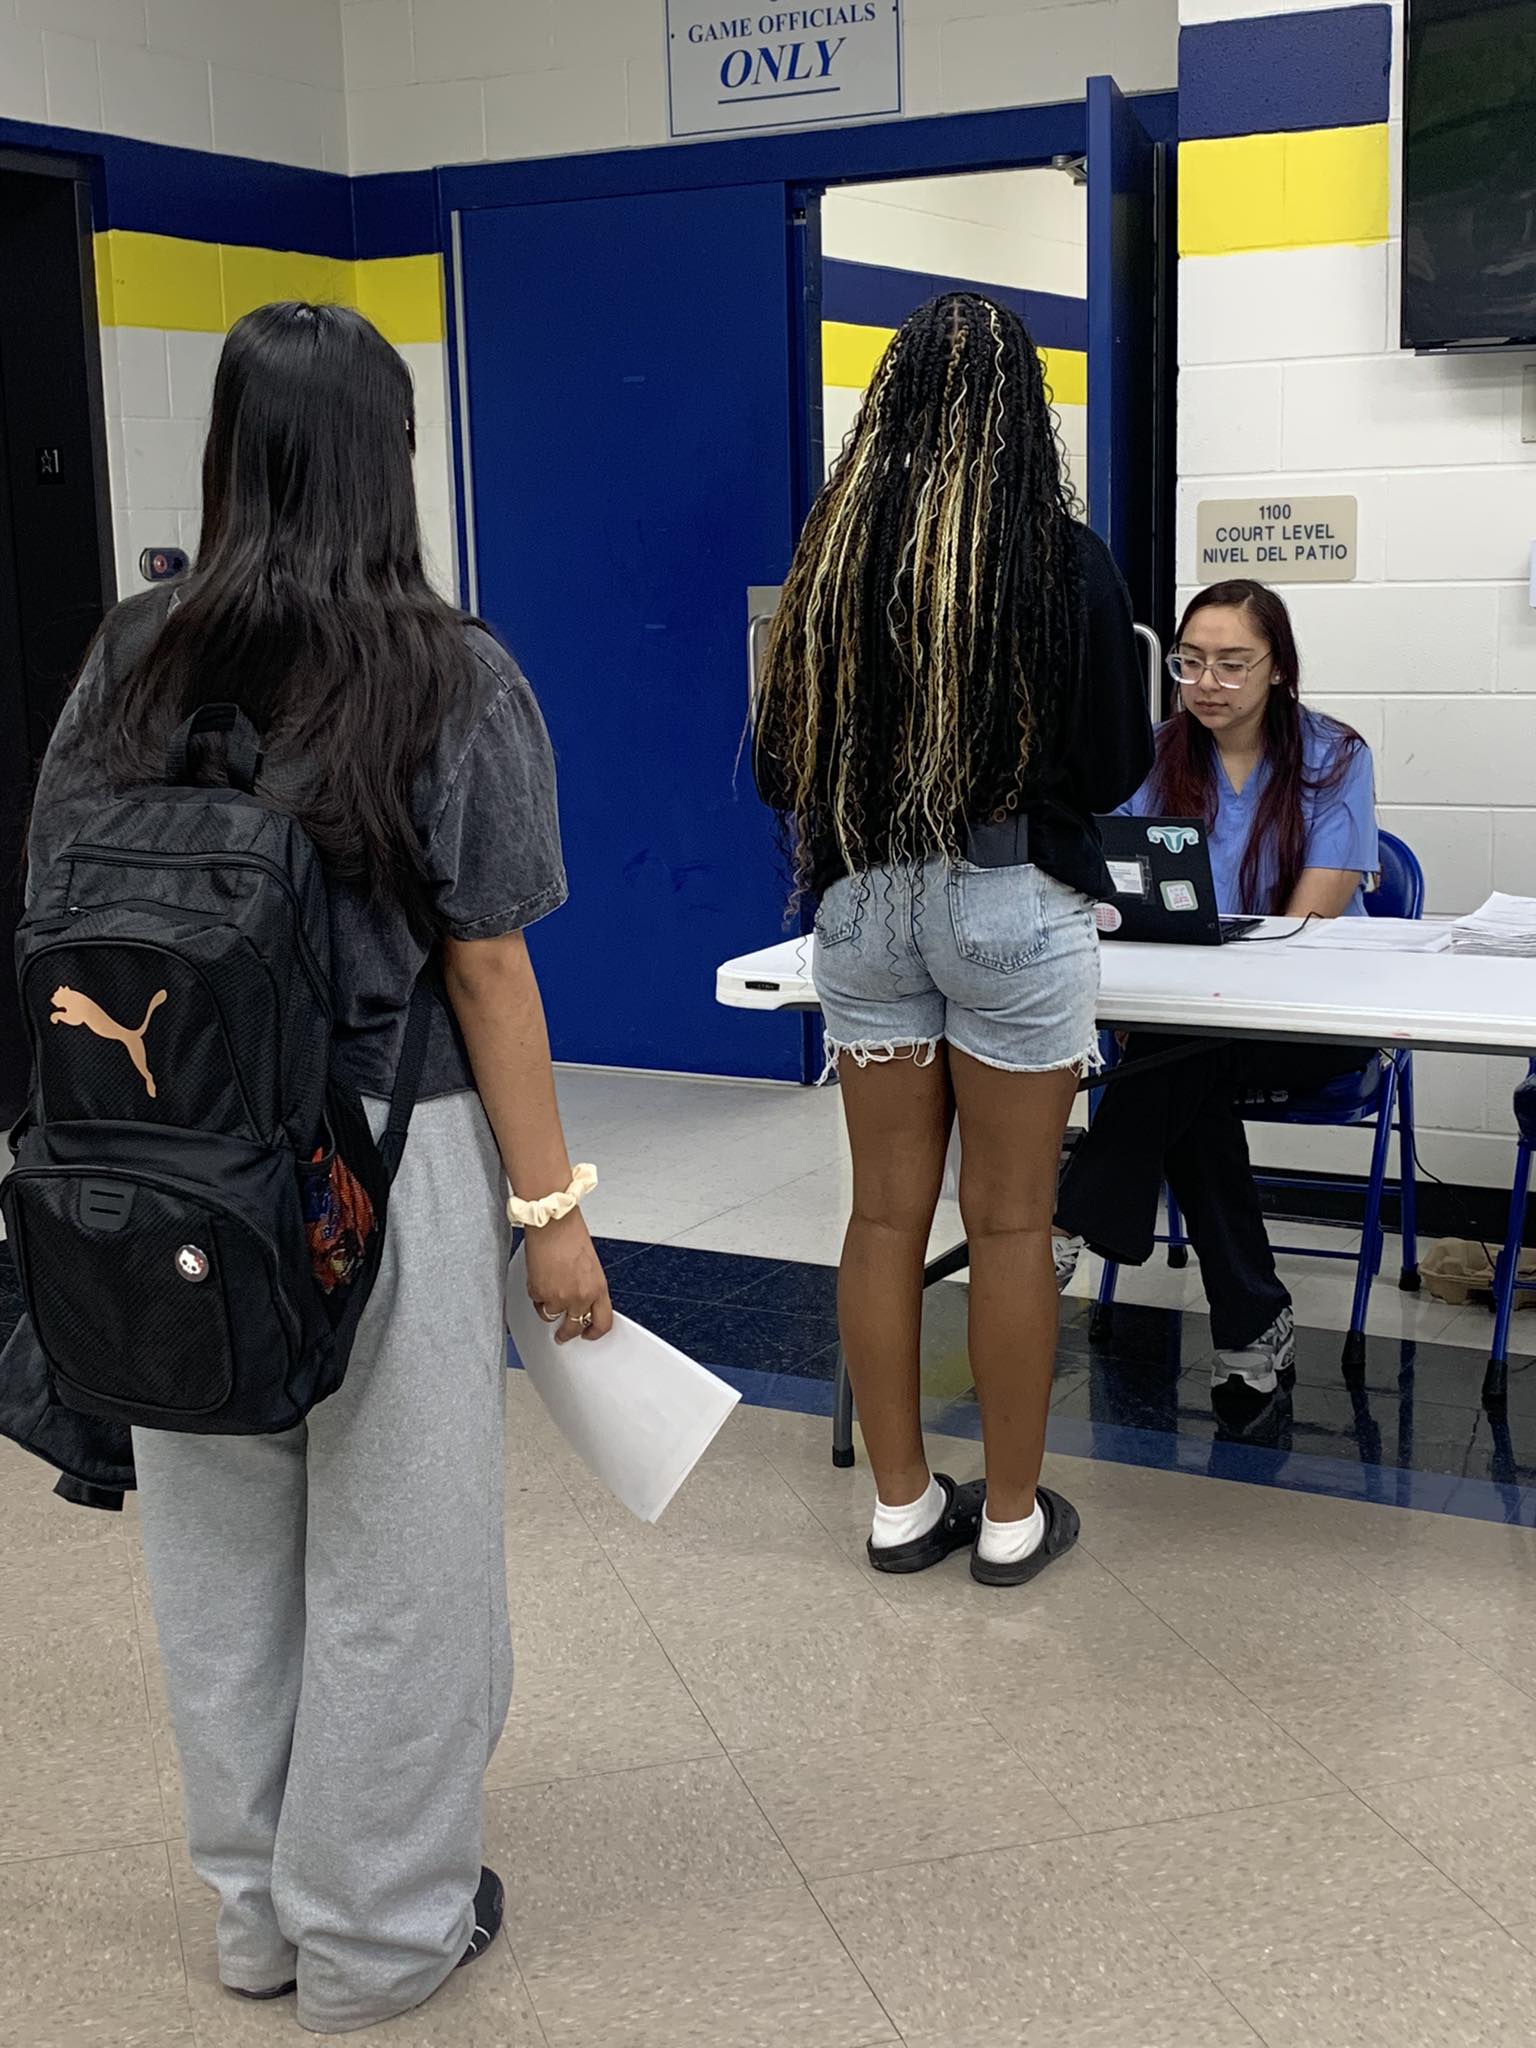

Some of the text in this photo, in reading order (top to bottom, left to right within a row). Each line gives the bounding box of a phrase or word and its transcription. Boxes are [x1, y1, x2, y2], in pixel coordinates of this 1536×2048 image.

[688, 3, 876, 44] GAME OFFICIALS
[719, 37, 847, 88] ONLY
[1258, 503, 1292, 520] 1100
[1215, 524, 1335, 542] COURT LEVEL
[1203, 544, 1348, 563] NIVEL DEL PATIO
